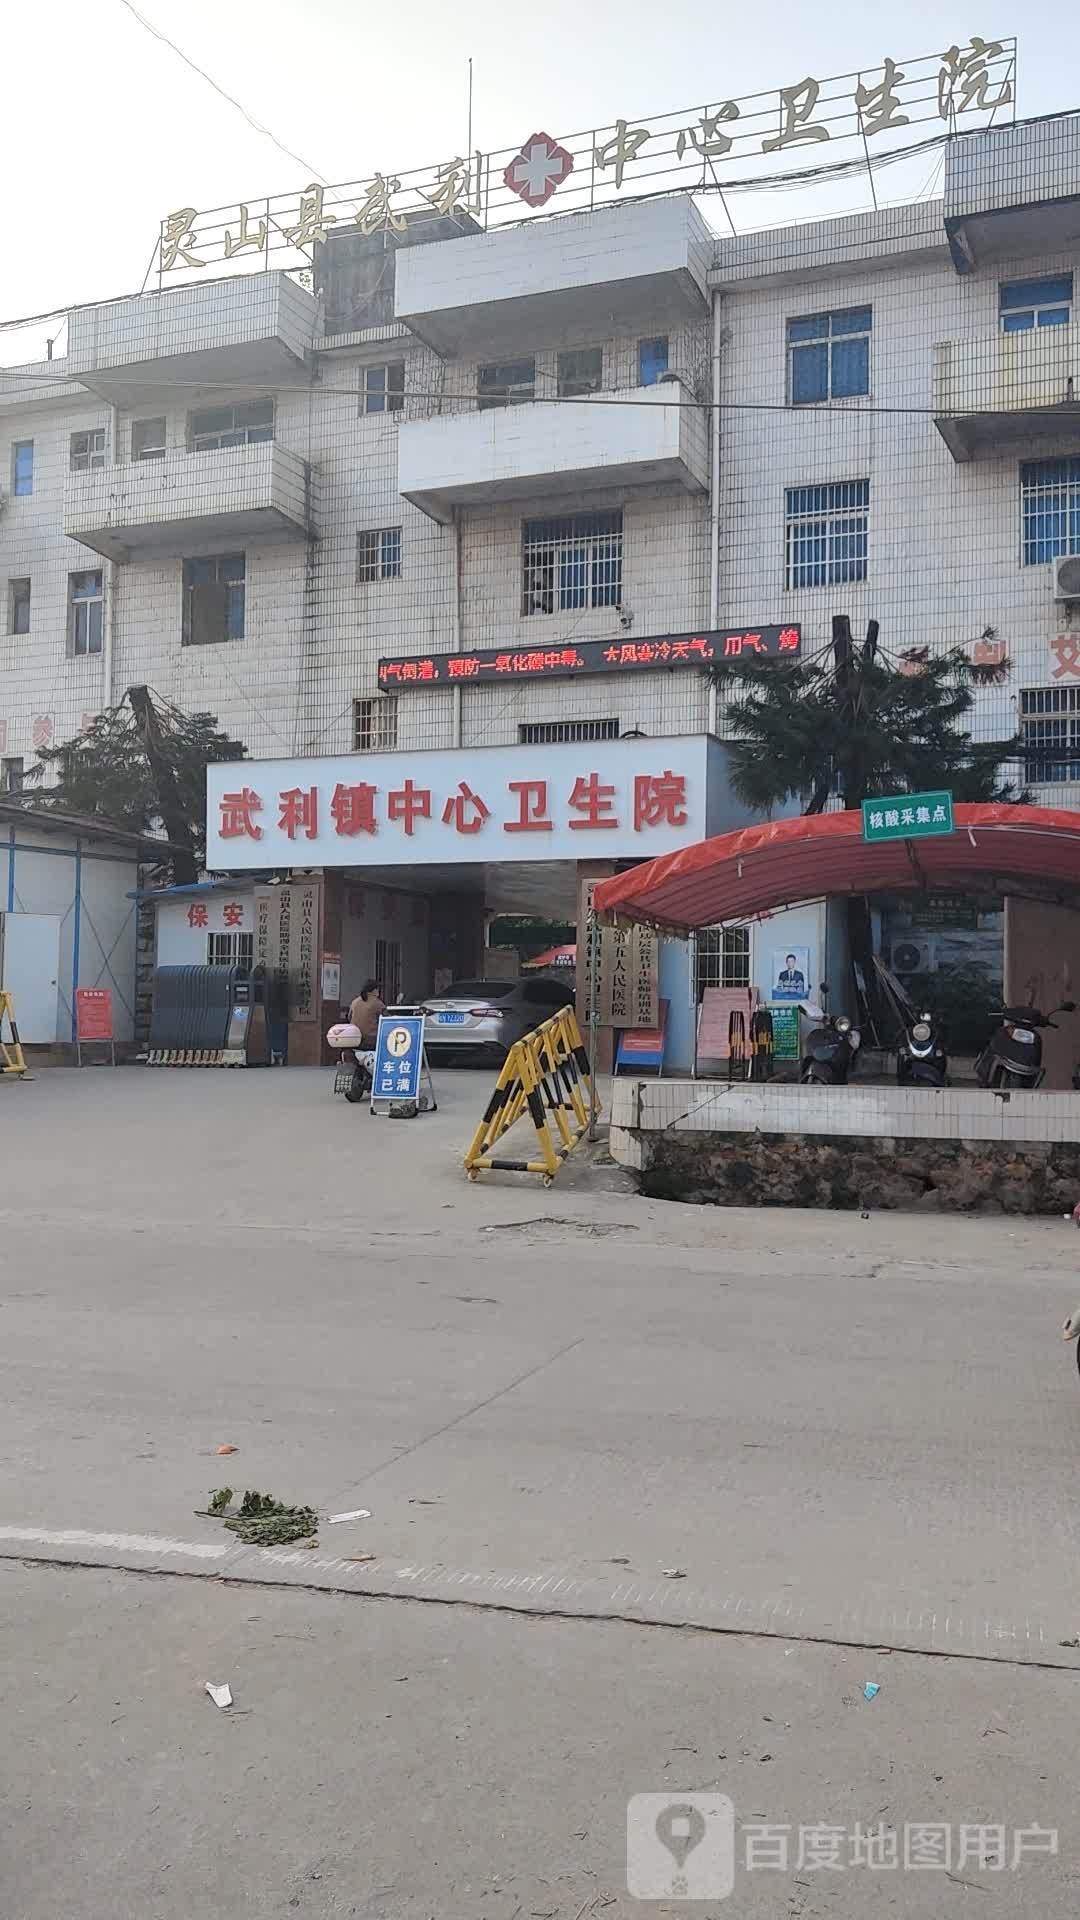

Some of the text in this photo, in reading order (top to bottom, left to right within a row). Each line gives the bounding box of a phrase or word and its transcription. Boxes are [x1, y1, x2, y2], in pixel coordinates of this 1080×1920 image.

[161, 36, 1013, 270] 灵山县武利 中心卫生院
[218, 770, 689, 842] 武利镇中心卫生院
[868, 804, 947, 830] 核酸采集点
[187, 902, 245, 928] 保安
[381, 1059, 412, 1075] 车位
[380, 1077, 410, 1092] 已满
